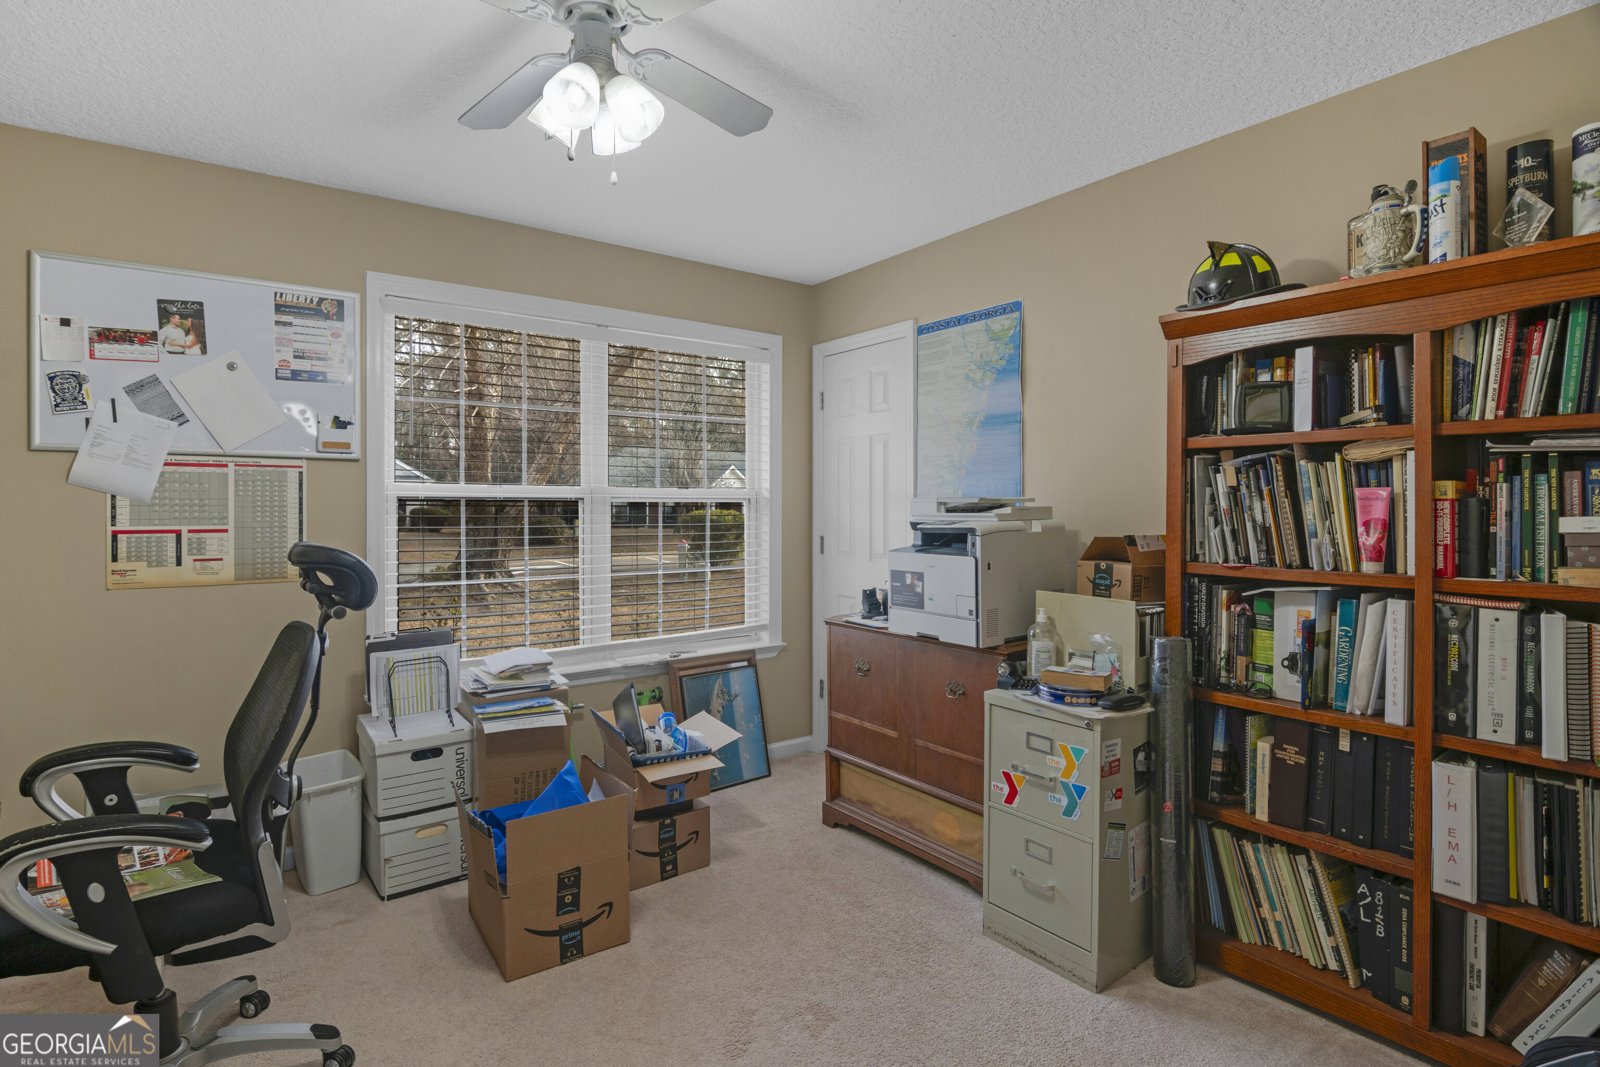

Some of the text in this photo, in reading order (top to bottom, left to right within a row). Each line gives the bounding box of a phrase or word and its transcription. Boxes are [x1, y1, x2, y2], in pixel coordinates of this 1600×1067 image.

[1507, 170, 1549, 188] SPEYBURN
[276, 292, 320, 305] LIBERTY
[921, 304, 1014, 334] COASTAL GEORGIA
[1497, 318, 1505, 352] ROCKWELL'S
[1492, 354, 1501, 385] CHRISTMAS
[1443, 514, 1451, 545] COMPLETE
[1536, 485, 1546, 568] TROPICAL FISH BOOK
[1488, 624, 1496, 651] NATIONAL
[1336, 626, 1353, 685] GARDENING
[1391, 609, 1399, 707] CERTIFICATES
[1488, 654, 1496, 689] ELECTRICAL
[456, 746, 469, 799] universal
[1047, 757, 1061, 767] the
[993, 782, 1005, 793] the
[1048, 794, 1062, 804] the
[1447, 827, 1459, 865] EMA
[1444, 878, 1461, 887] GEMA
[561, 930, 581, 941] prime
